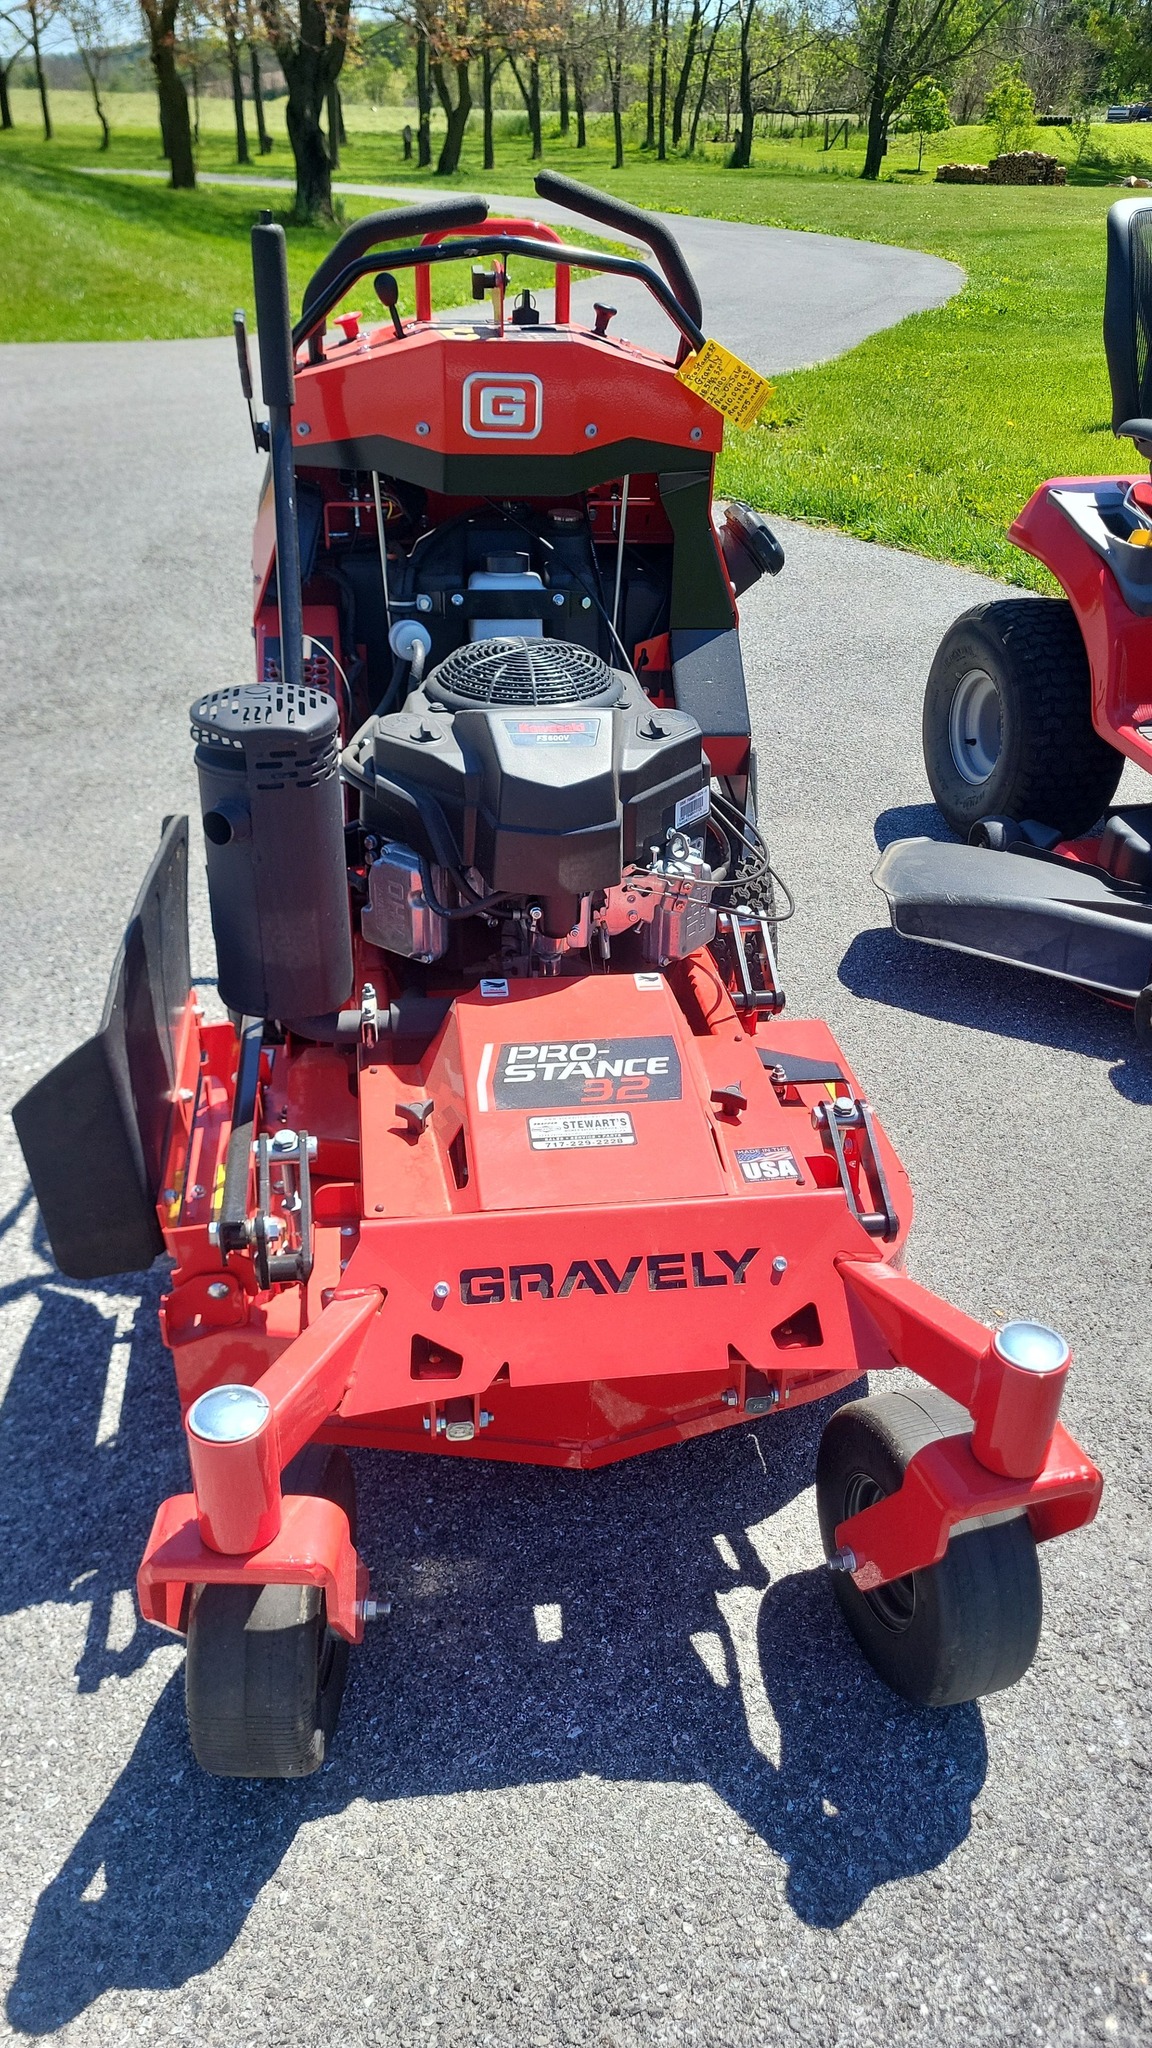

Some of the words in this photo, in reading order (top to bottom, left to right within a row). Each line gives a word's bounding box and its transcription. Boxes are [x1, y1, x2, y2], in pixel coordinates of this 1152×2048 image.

[695, 355, 722, 385] Gravely
[480, 387, 526, 426] G
[518, 722, 586, 733] Kawasaki
[536, 734, 570, 742] FS600V
[507, 1043, 610, 1065] PRO-
[503, 1056, 670, 1083] STANCE
[580, 1077, 651, 1103] 32
[562, 1118, 627, 1129] STEWART'S
[545, 1138, 624, 1148] 717-229-2228
[741, 1159, 799, 1179] USA
[459, 1247, 762, 1306] GRAVELY
